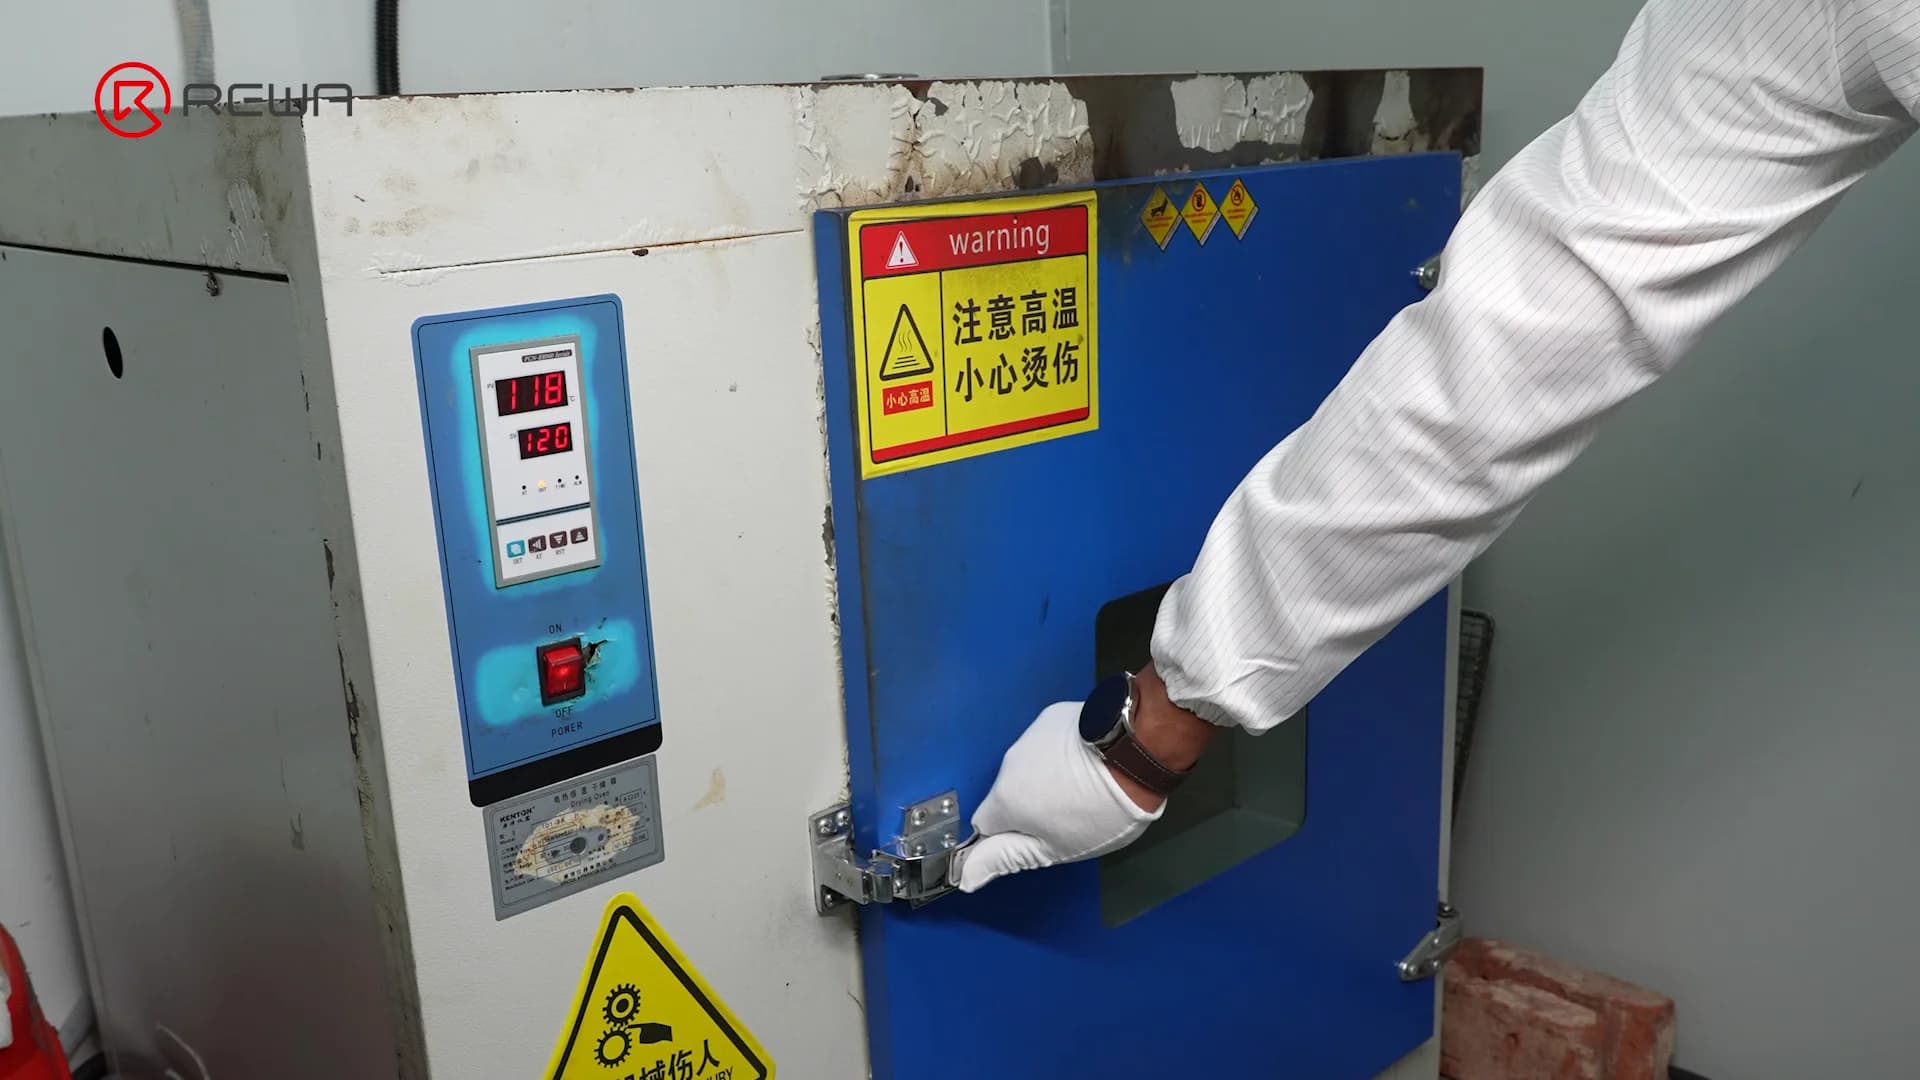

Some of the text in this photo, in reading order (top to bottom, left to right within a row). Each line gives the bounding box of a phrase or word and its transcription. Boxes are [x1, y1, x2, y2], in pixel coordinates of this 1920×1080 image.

[949, 219, 1050, 255] warning
[952, 286, 1079, 346] 注意高温
[955, 342, 1080, 402] 小心烫伤
[510, 371, 563, 410] 118
[885, 387, 931, 409] 小心高温
[527, 424, 569, 452] 120
[548, 623, 562, 634] ON
[555, 706, 574, 719] OFF
[551, 720, 584, 737] POWER
[499, 807, 533, 823] KENTON
[615, 1038, 721, 1080] 械伤人
